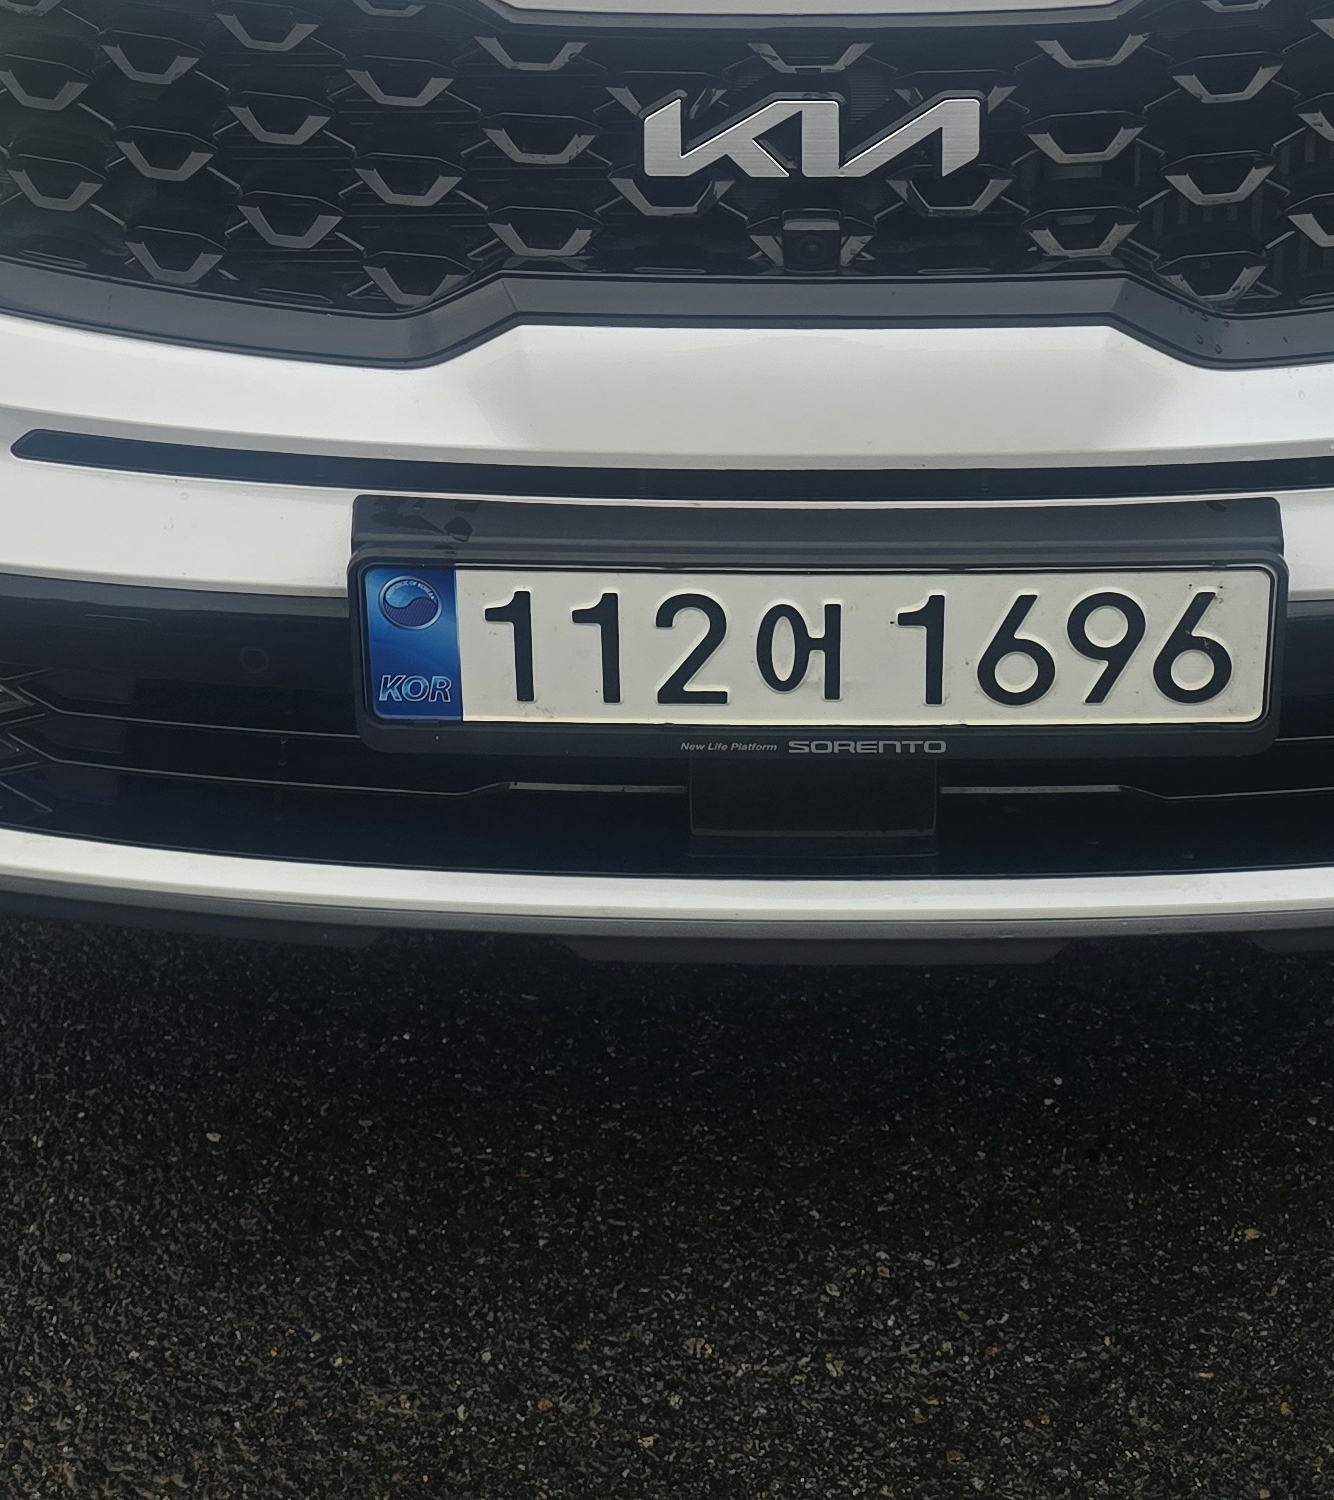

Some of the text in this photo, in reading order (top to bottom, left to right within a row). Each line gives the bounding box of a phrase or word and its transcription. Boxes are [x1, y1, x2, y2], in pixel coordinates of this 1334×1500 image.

[643, 97, 981, 178] KIA
[484, 590, 1233, 706] 112어 1696
[378, 674, 452, 702] KOR
[680, 740, 947, 754] New Life Platform SORENTO
